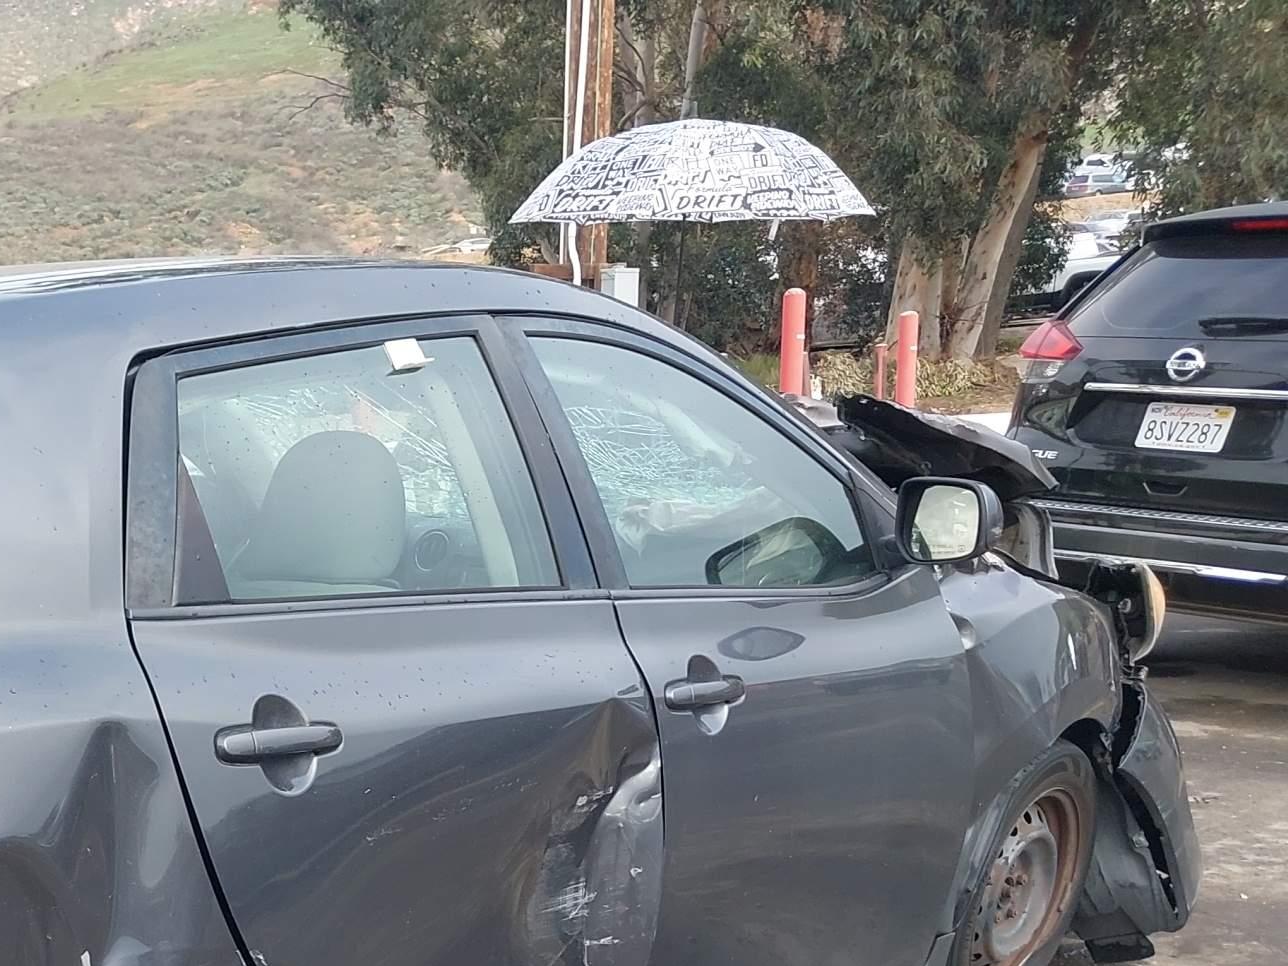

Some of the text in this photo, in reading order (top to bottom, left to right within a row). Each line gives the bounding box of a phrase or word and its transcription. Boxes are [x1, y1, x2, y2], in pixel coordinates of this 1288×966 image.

[554, 194, 616, 213] DRIFT
[676, 194, 743, 210] DRIFT
[1144, 419, 1223, 445] 8SVZ287
